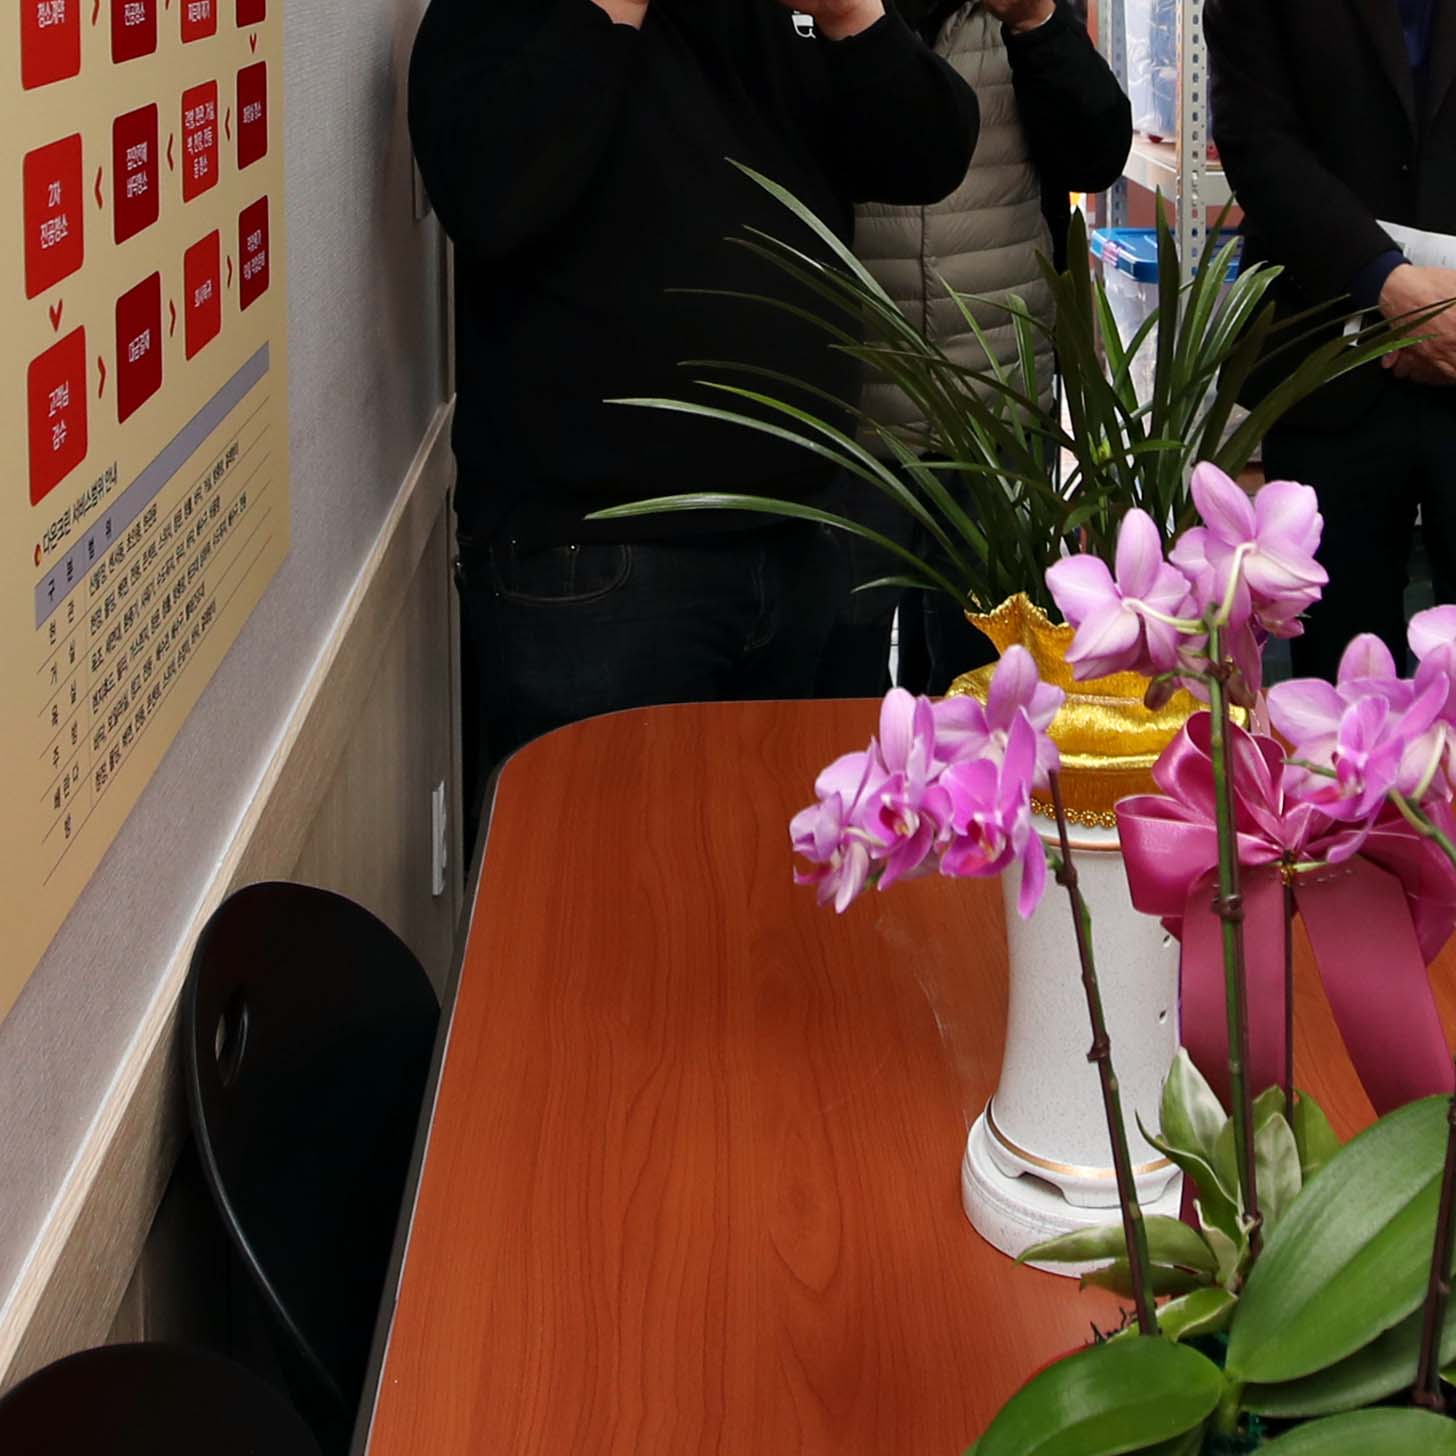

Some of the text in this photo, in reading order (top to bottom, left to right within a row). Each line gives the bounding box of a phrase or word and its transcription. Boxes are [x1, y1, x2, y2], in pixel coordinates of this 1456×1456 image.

[47, 178, 61, 210] 2차
[39, 210, 68, 252] 진공청소
[47, 378, 70, 422] 고객님
[51, 414, 67, 455] 검수
[42, 503, 71, 561] 다온크린
[104, 458, 118, 496] 안내
